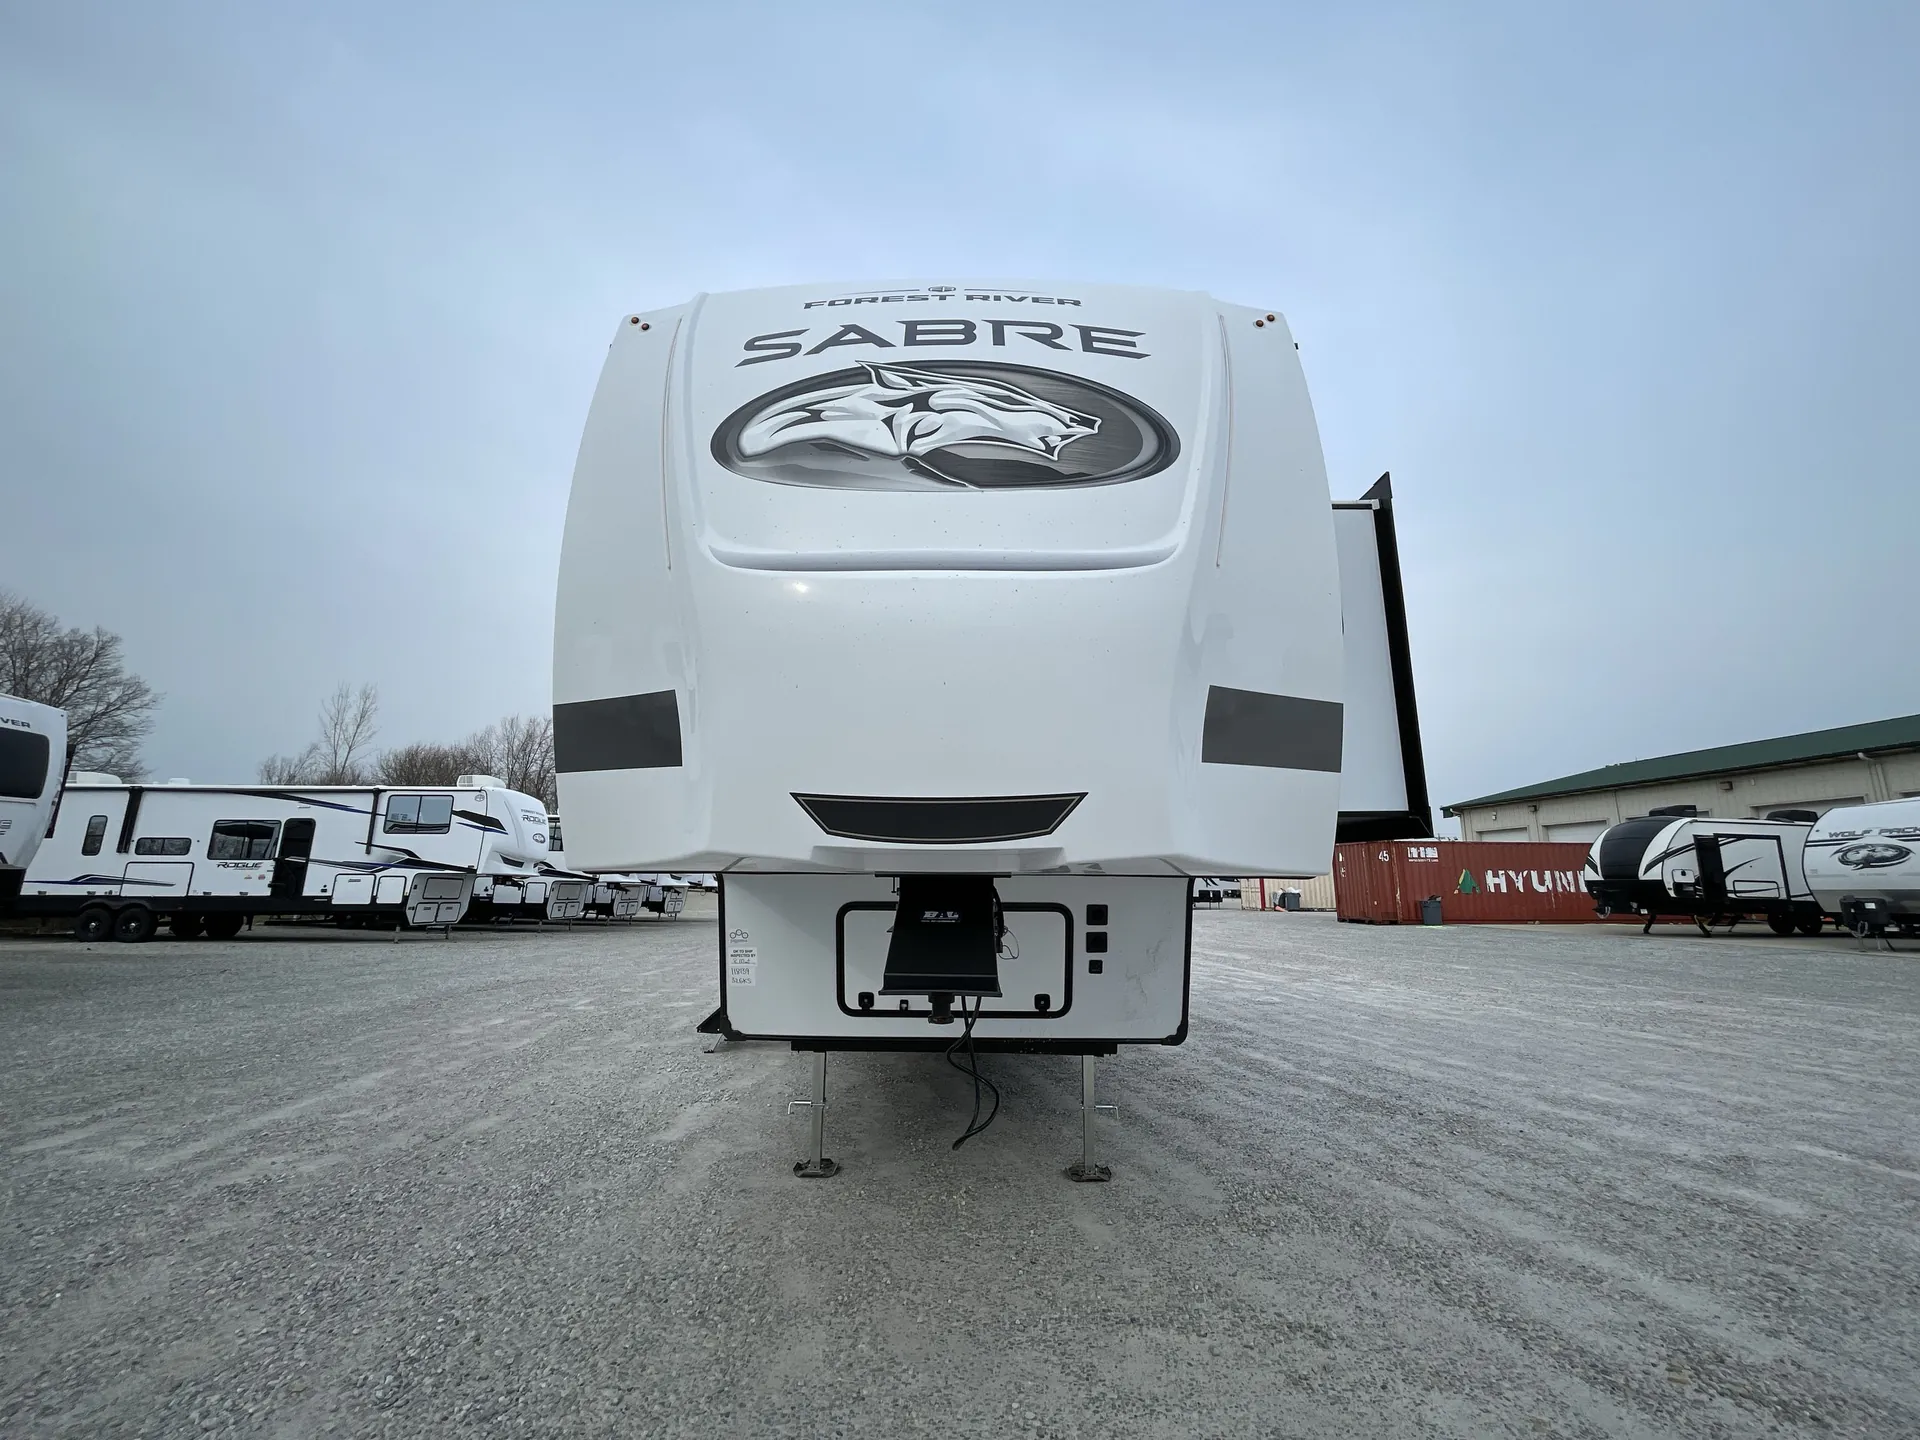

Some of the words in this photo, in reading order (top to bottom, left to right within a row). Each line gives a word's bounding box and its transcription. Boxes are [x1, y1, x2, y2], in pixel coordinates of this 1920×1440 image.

[803, 294, 956, 310] FOREST
[964, 294, 1083, 308] RIVER
[734, 318, 1152, 368] SABRE
[1828, 829, 1873, 838] WOLF
[1378, 850, 1390, 862] 45
[216, 861, 264, 869] ROGUE
